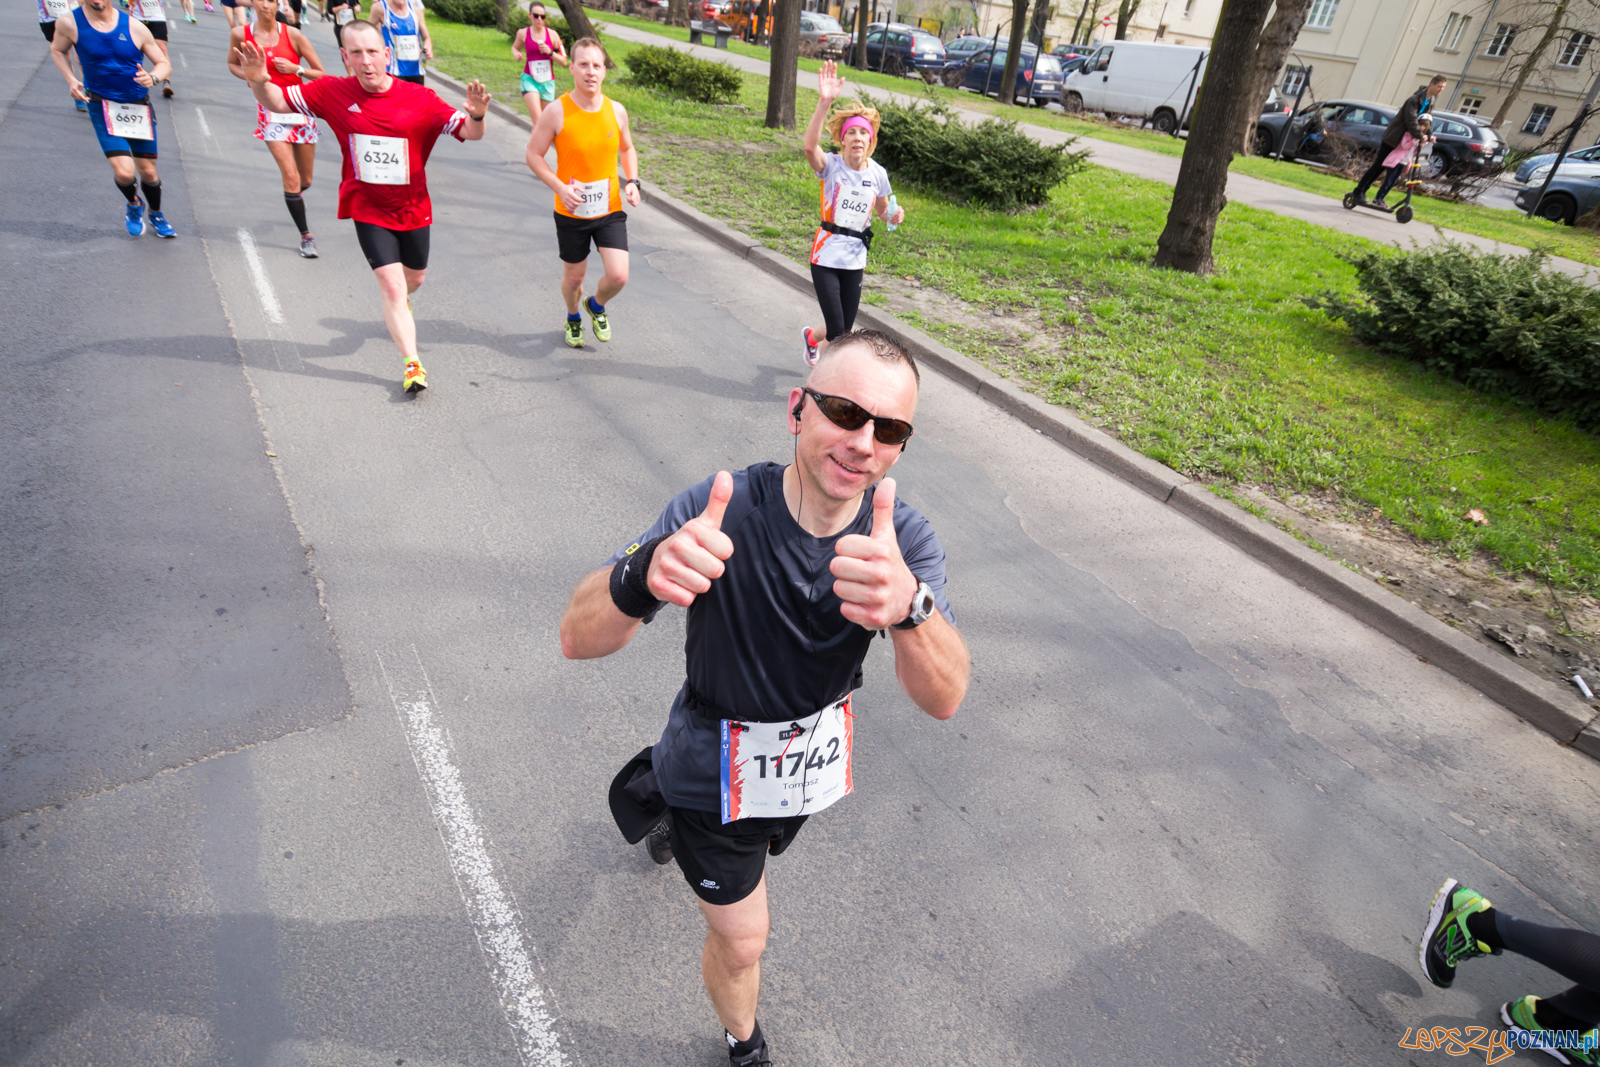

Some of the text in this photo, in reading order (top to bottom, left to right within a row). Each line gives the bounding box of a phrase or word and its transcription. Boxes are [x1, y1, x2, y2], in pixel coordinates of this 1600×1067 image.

[116, 113, 143, 124] 6697
[363, 151, 399, 165] 6324
[580, 192, 603, 203] 8119
[841, 199, 868, 214] 8462
[753, 736, 840, 779] 11742
[783, 778, 819, 790] Tomasz
